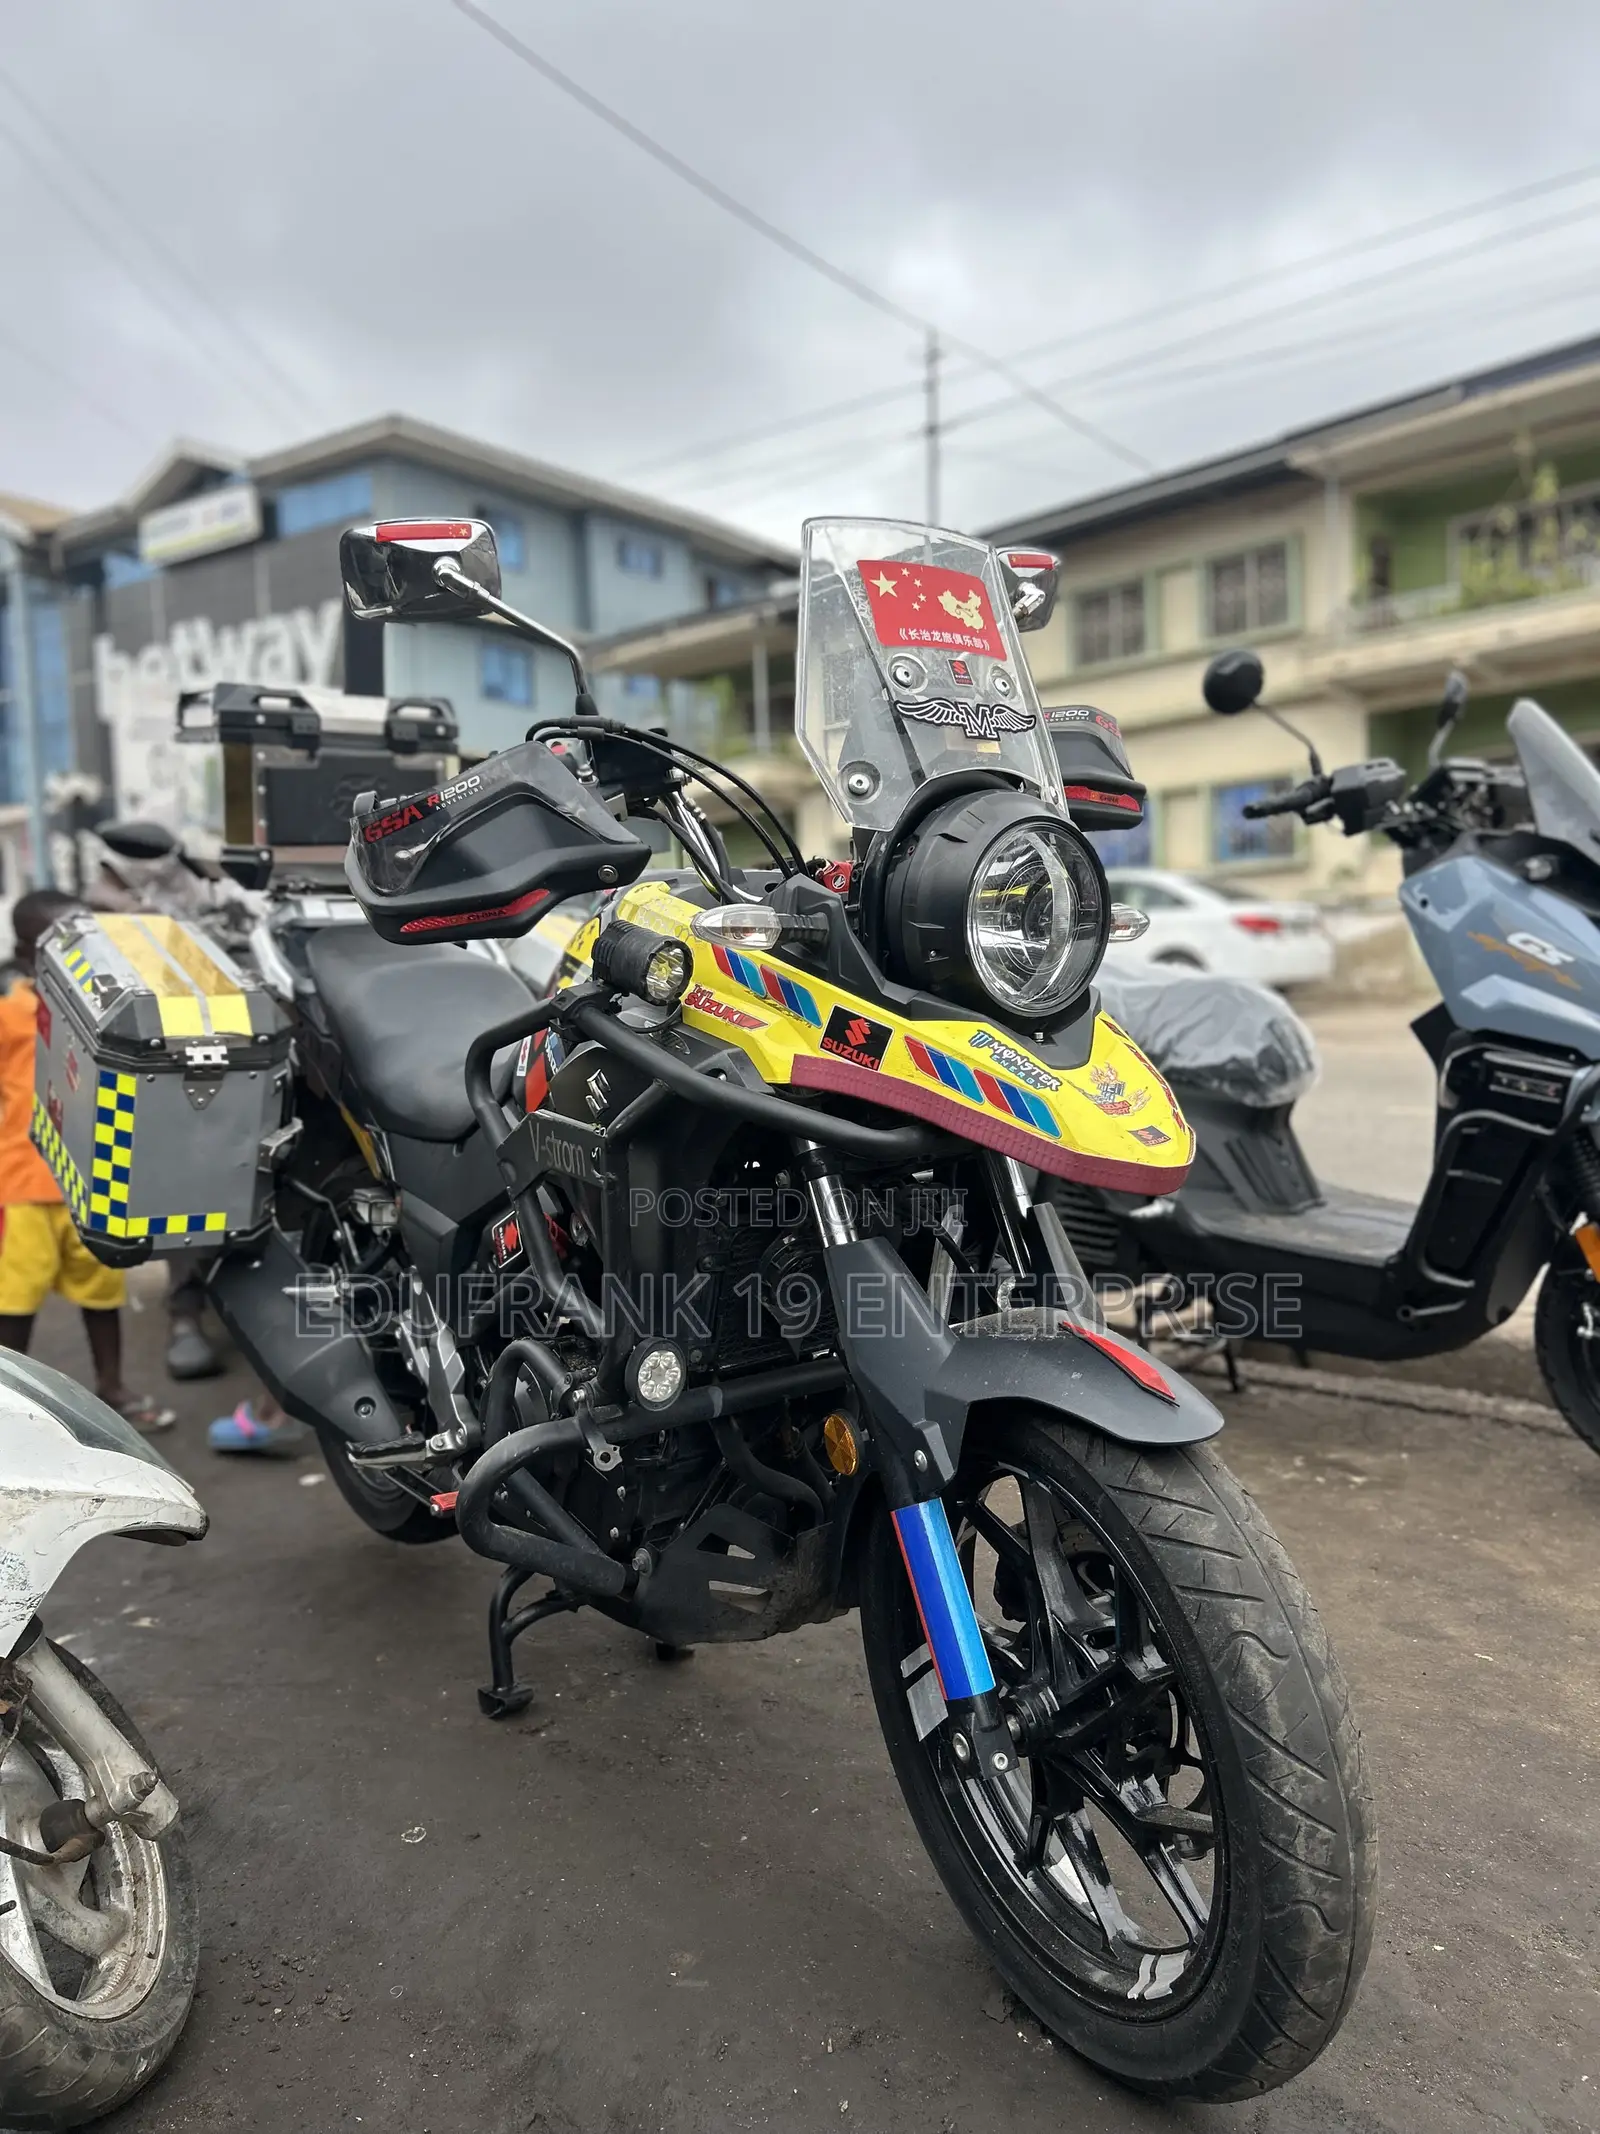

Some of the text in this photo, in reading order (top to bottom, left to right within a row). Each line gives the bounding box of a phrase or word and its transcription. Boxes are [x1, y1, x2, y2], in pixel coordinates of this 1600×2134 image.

[436, 785, 484, 811] ADVENTURE
[364, 804, 424, 843] GSA
[684, 993, 746, 1027] SUZUKI
[822, 1036, 880, 1070] SUZUKI
[989, 1041, 1061, 1091] MONSTER
[991, 1054, 1045, 1089] ENERGY
